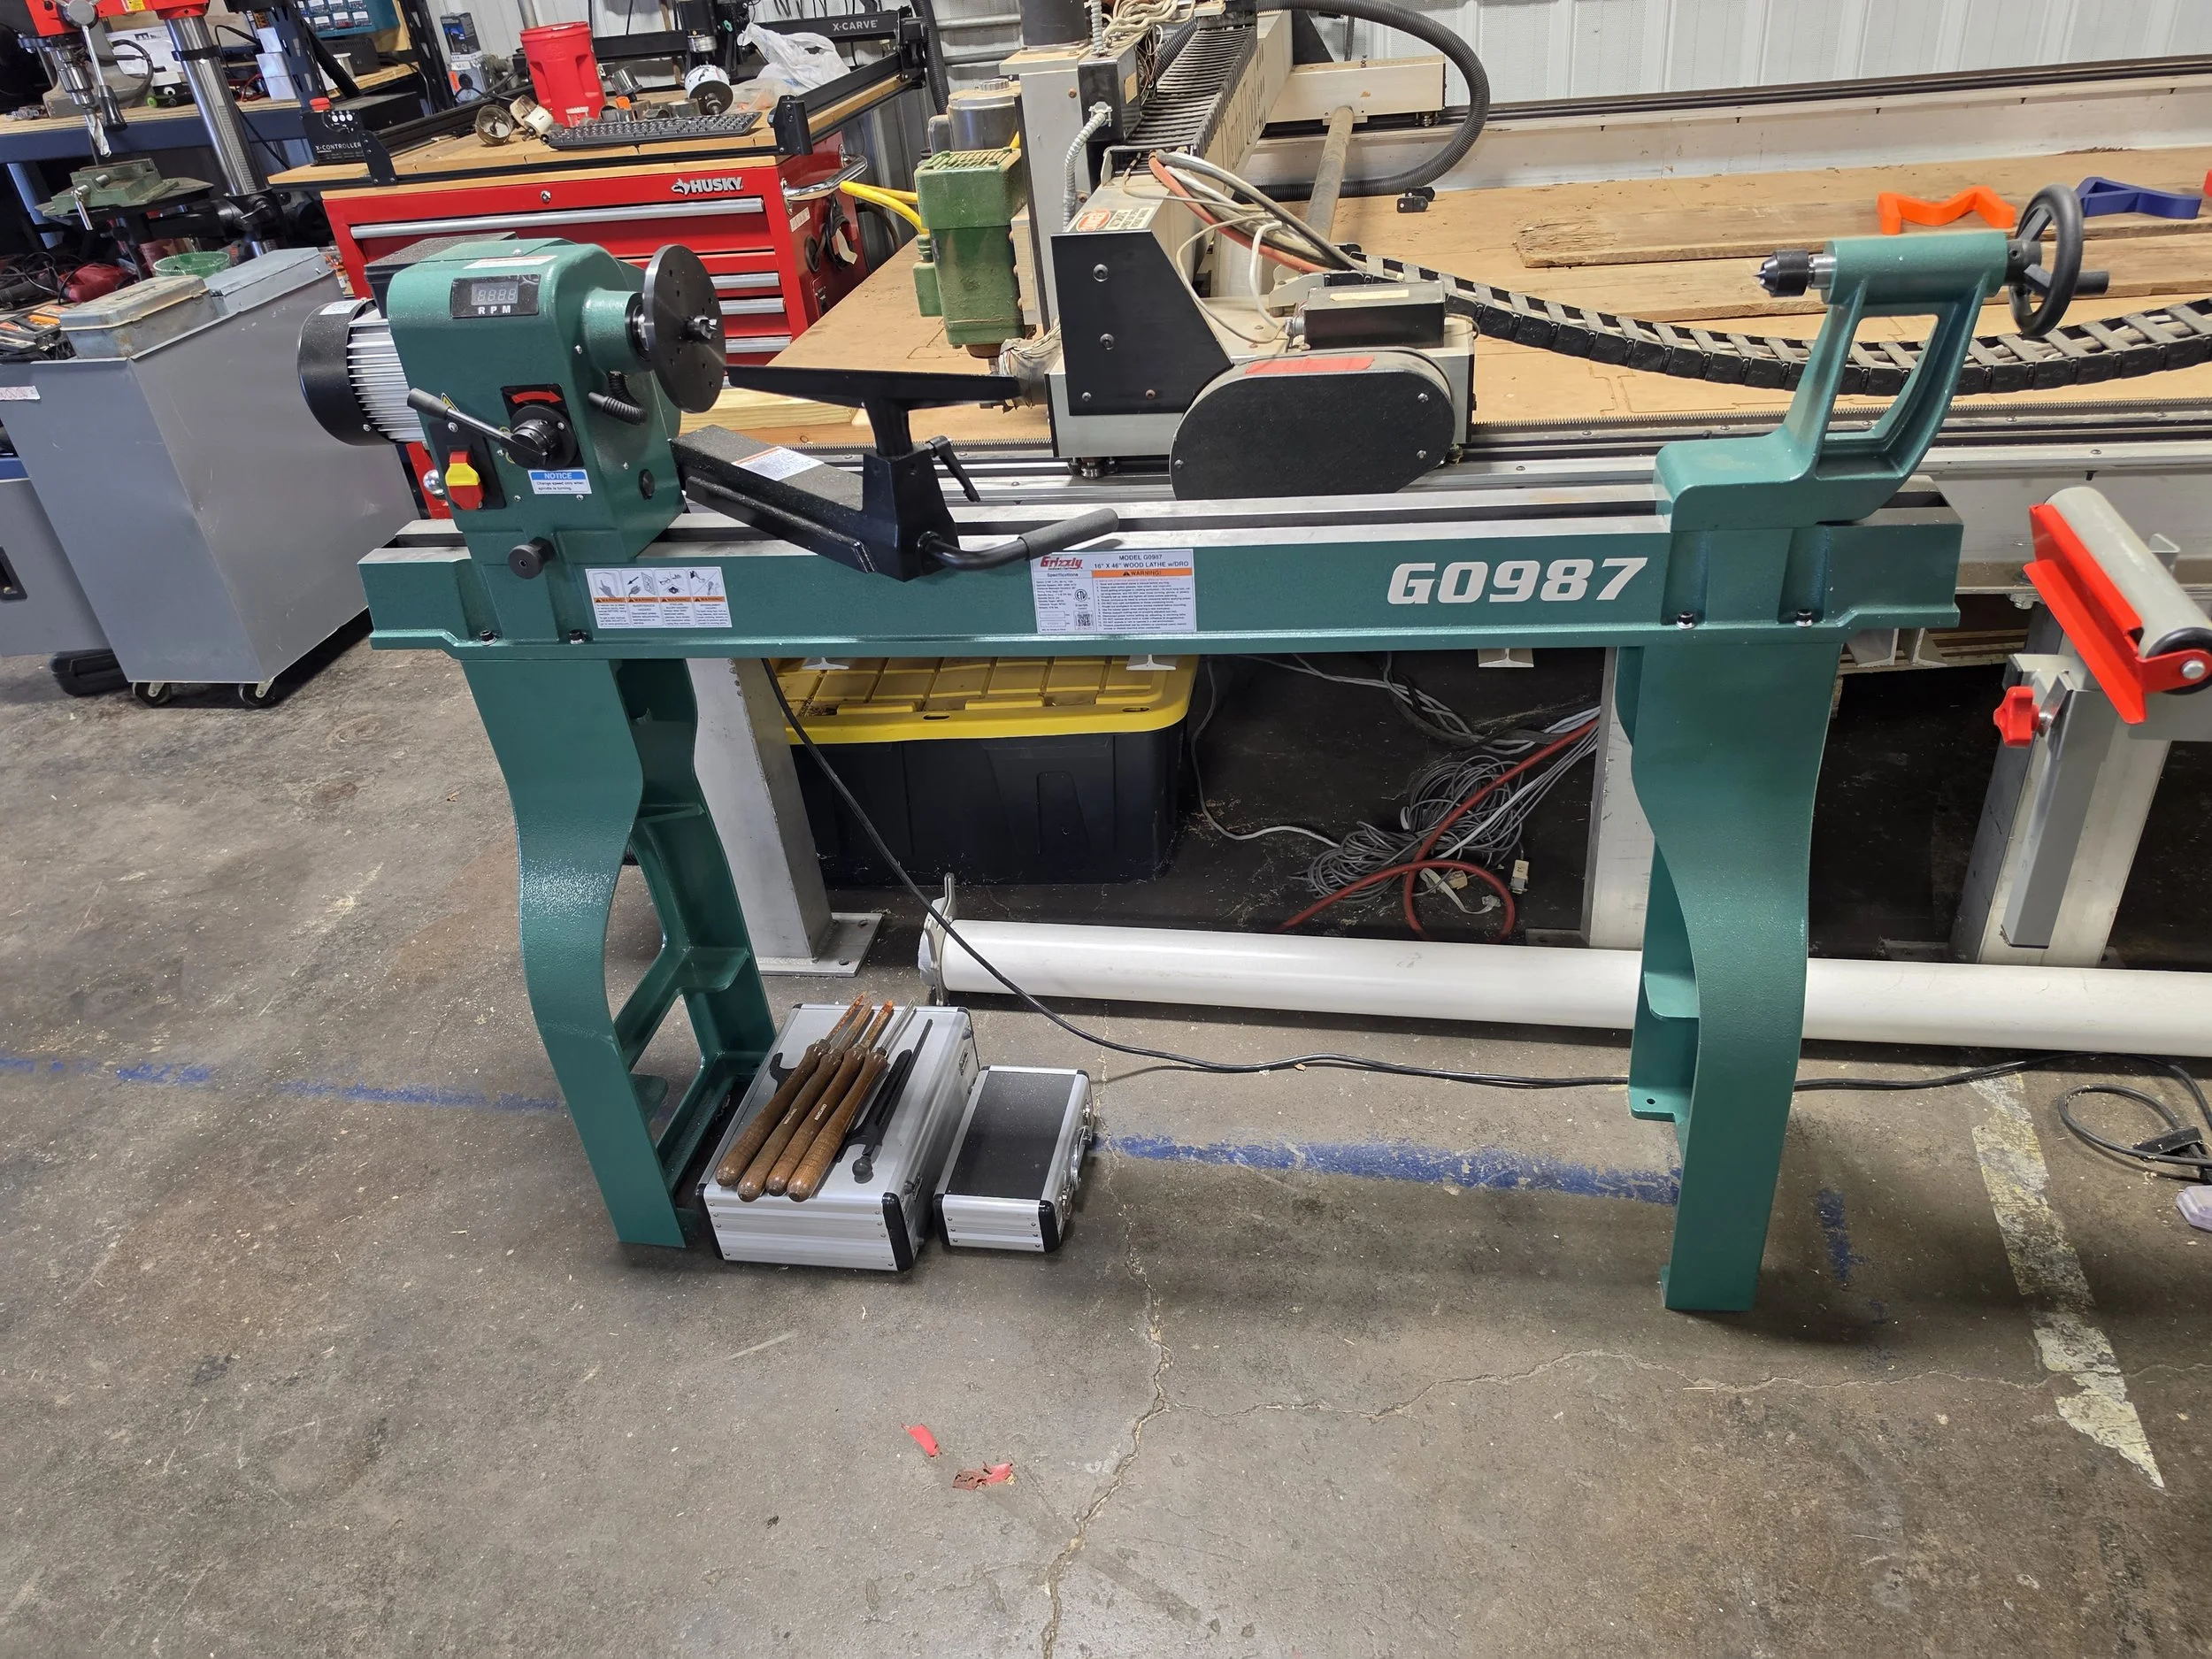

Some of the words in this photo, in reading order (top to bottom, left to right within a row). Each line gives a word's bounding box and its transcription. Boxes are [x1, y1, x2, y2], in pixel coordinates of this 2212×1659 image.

[690, 177, 743, 194] HUSKY
[478, 305, 511, 315] RPM
[1041, 556, 1083, 570] Grizzly
[1387, 557, 1648, 604] G0987
